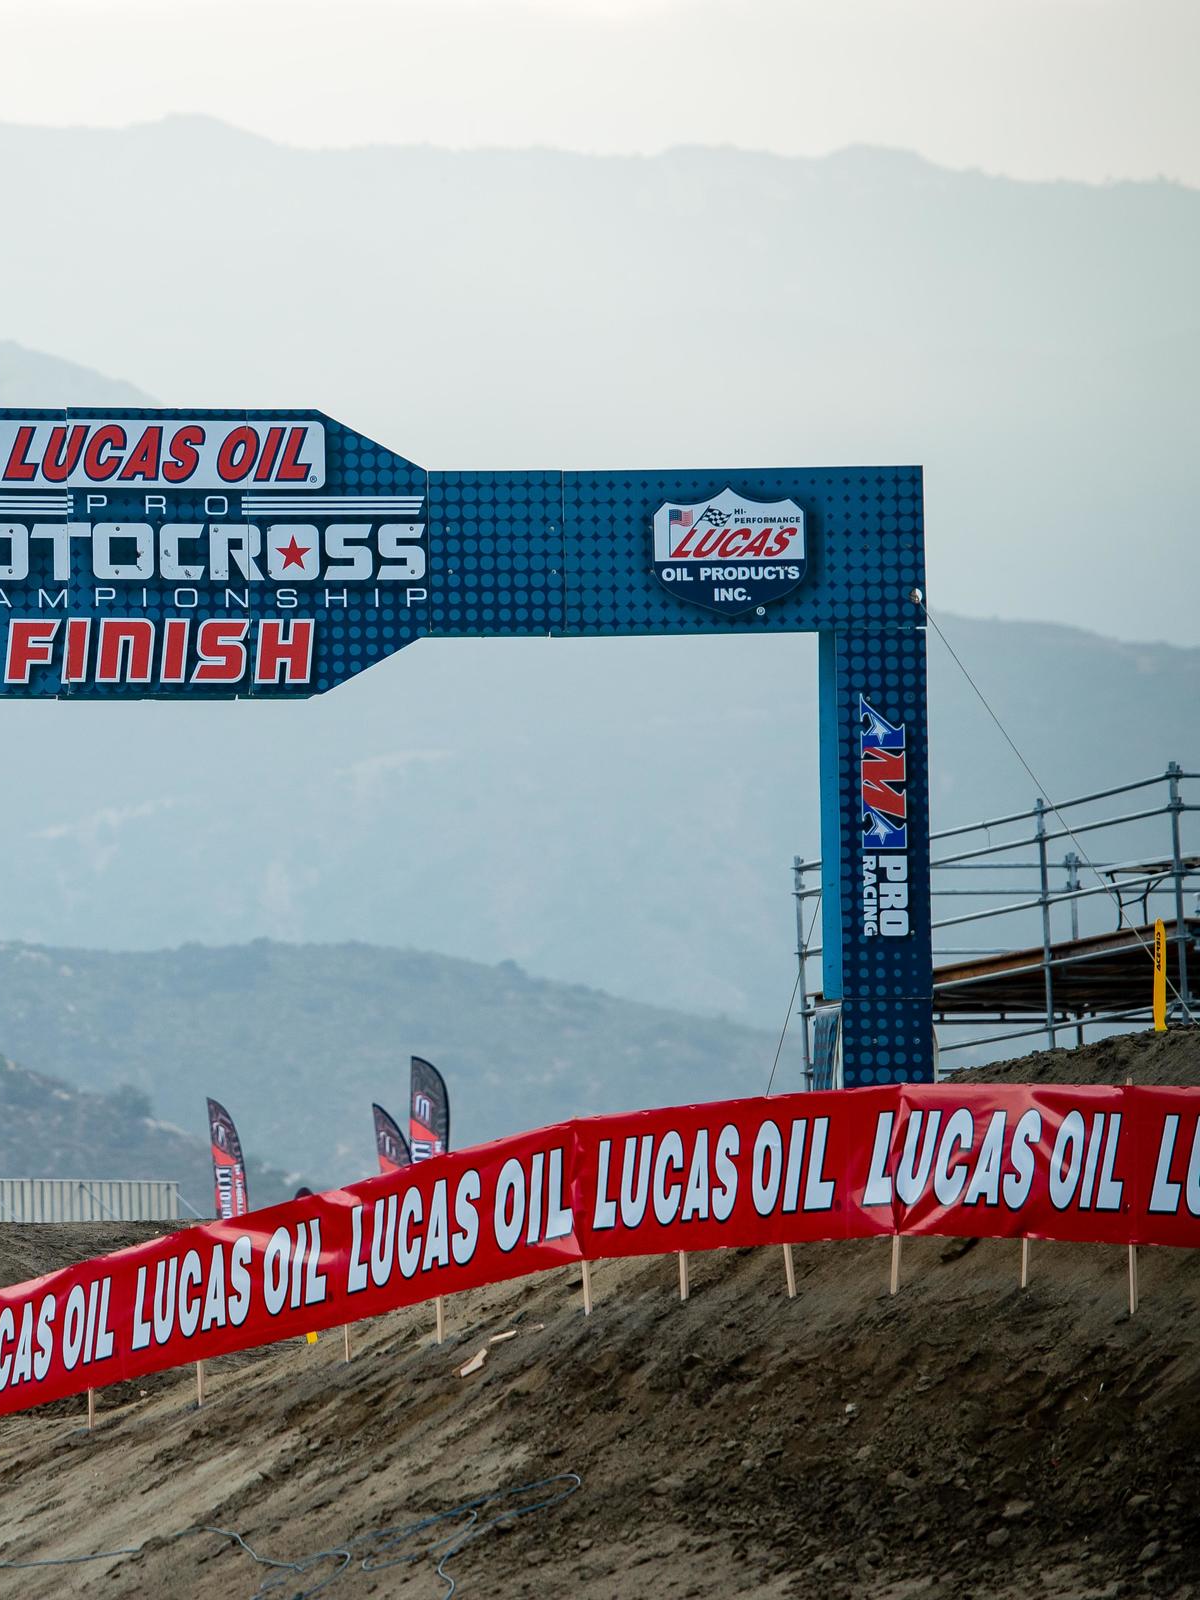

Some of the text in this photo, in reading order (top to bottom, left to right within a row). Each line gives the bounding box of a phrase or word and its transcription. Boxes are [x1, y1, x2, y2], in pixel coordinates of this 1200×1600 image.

[1, 424, 312, 483] LUCAS OIL
[87, 496, 228, 515] PRO
[734, 516, 800, 524] PERFORMANCE
[670, 527, 798, 558] LUCAS
[661, 565, 800, 582] OIL PRODUCTS
[713, 588, 752, 601] INC.
[3, 617, 315, 685] FINISH
[862, 855, 878, 937] RACING
[878, 855, 909, 936] PRO
[61, 1275, 114, 1371] OIL
[131, 1235, 252, 1351] LUCAS
[263, 1217, 327, 1317] OIL
[346, 1169, 481, 1294] LUCAS
[494, 1147, 573, 1253] OIL
[593, 1123, 740, 1230] LUCAS
[751, 1116, 836, 1217] OIL
[861, 1107, 1043, 1213] LUCAS
[1049, 1109, 1124, 1212] OIL
